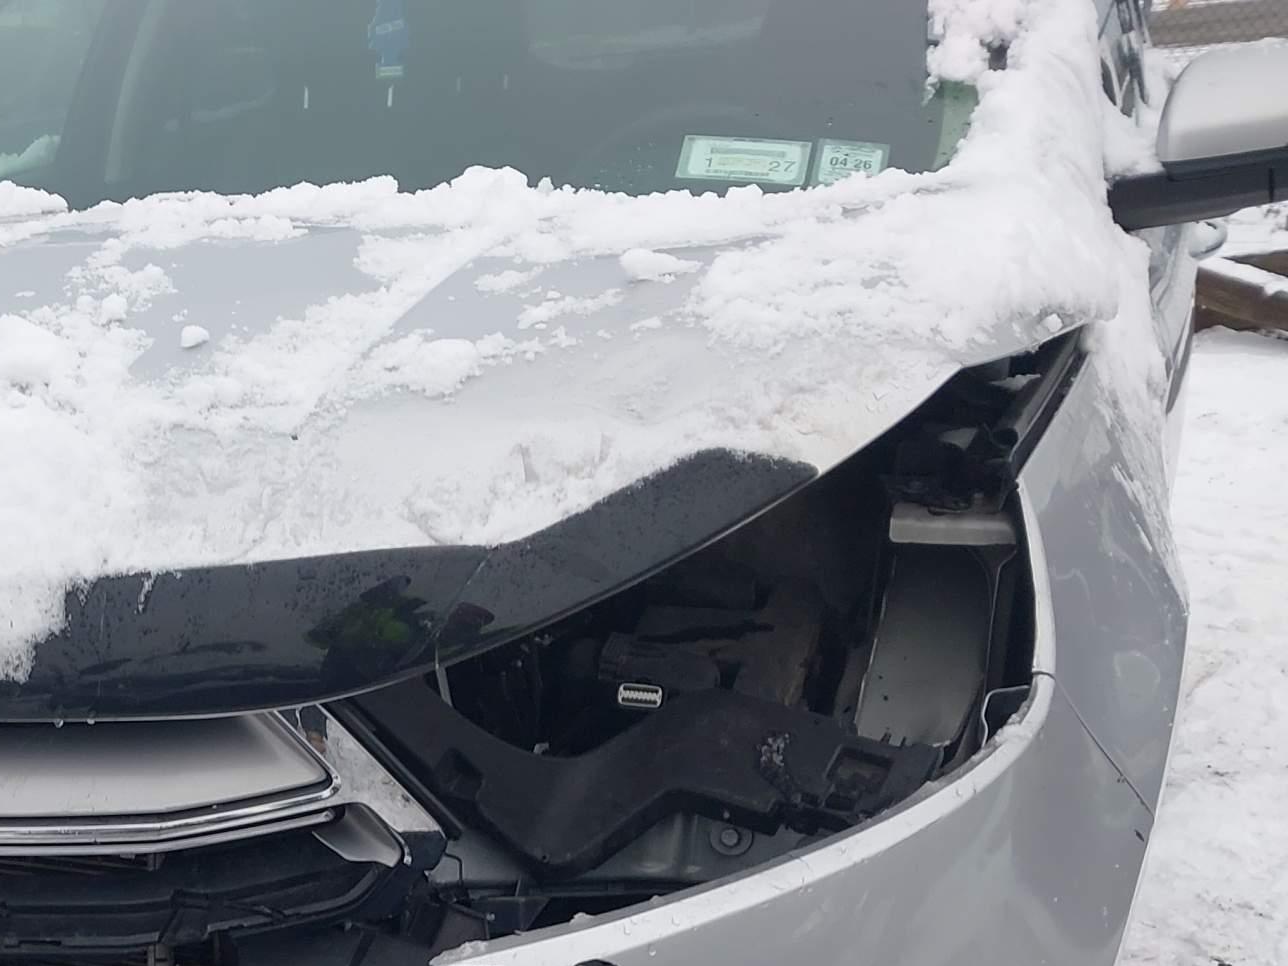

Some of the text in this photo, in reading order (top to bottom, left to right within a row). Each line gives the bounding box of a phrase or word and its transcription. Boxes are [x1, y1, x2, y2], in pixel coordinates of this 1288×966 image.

[768, 160, 797, 173] 27
[830, 156, 872, 169] 04 26
